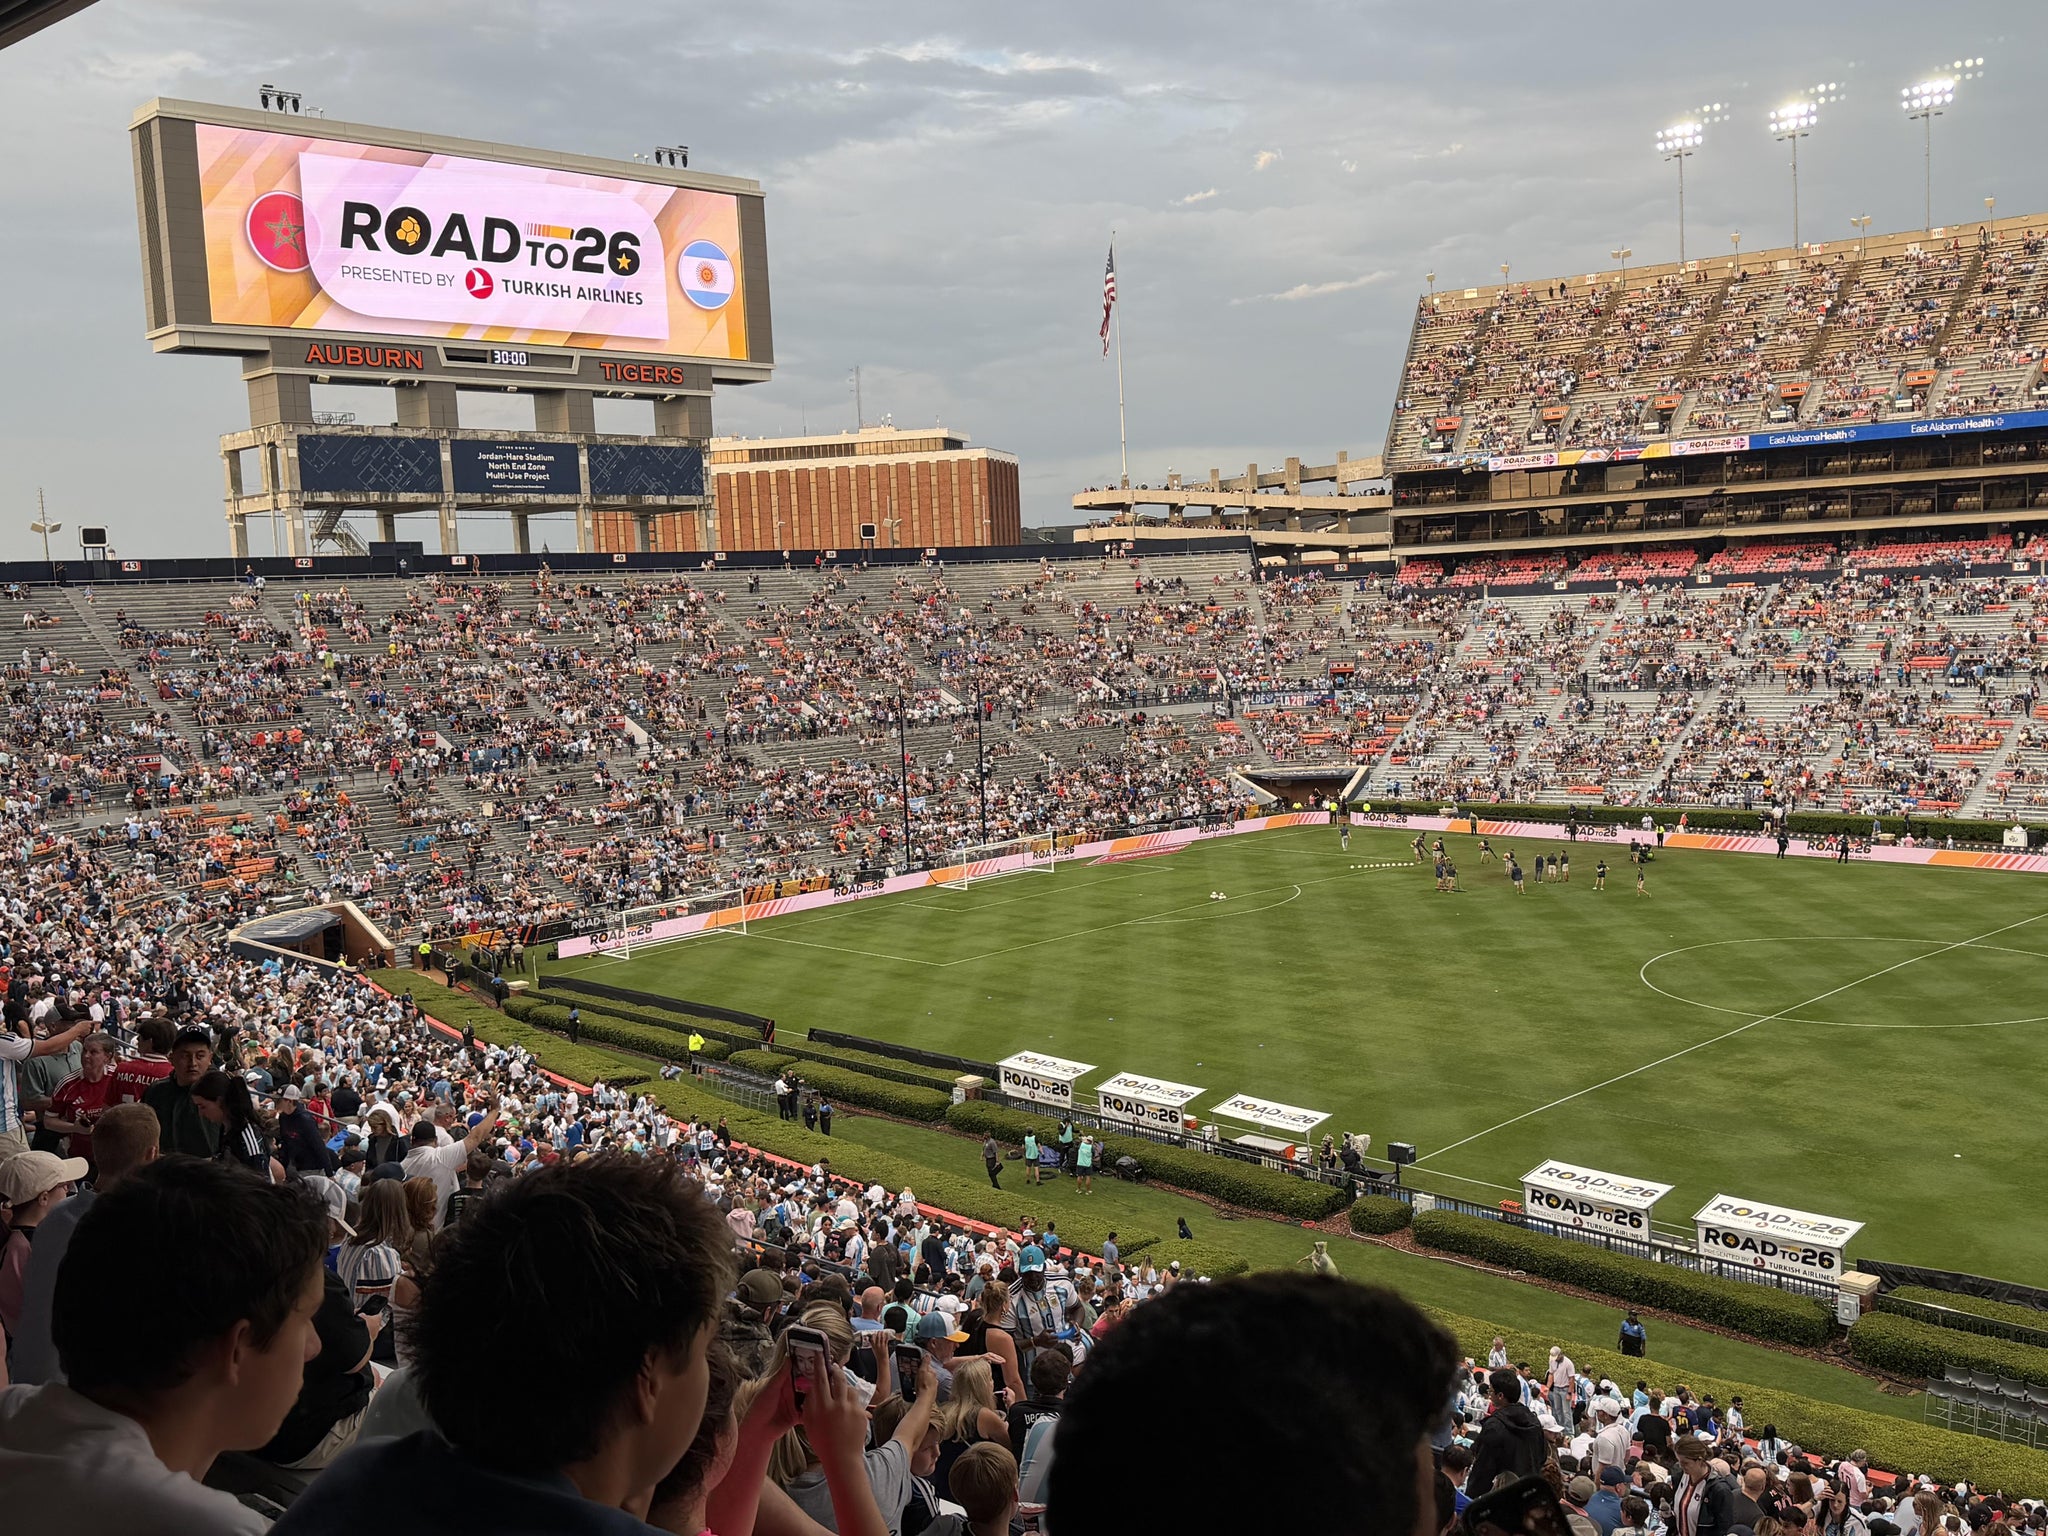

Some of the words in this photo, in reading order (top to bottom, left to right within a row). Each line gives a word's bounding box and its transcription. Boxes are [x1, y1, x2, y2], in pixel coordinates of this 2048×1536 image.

[340, 200, 521, 263] ROAD
[525, 241, 568, 269] TO
[572, 227, 641, 277] 26
[341, 265, 432, 286] PRESENTED
[436, 274, 455, 287] BY
[502, 279, 572, 299] TURKISH
[576, 286, 643, 305] AIRLINES
[305, 343, 423, 369] AUBURN
[494, 350, 527, 365] 30:00
[599, 361, 684, 384] TIGERS
[1911, 424, 1928, 433] East
[1769, 435, 1785, 445] East
[477, 452, 524, 460] Jordan-Hare
[525, 453, 555, 461] Stadium
[524, 472, 550, 481] Project
[1363, 813, 1388, 822] ROAD
[1396, 815, 1407, 823] 26
[1199, 824, 1220, 834] ROAD
[1564, 825, 1594, 836] RAD
[1604, 828, 1617, 837] 26
[1064, 845, 1074, 855] 26
[1855, 845, 1871, 853] 26
[834, 882, 863, 898] ROAD
[872, 880, 884, 890] 26
[571, 917, 600, 930] ROAD
[637, 923, 652, 935] 26
[117, 1072, 134, 1082] MAC
[1004, 1070, 1040, 1090] ROAD
[1041, 1084, 1051, 1093] TO
[1051, 1082, 1069, 1097] 26
[1112, 1078, 1160, 1091] ROAD
[1169, 1089, 1194, 1098] 26
[1103, 1096, 1145, 1116] ROAD
[1146, 1110, 1158, 1119] TO
[1159, 1108, 1179, 1124] 26
[1228, 1100, 1281, 1115] ROAD
[1290, 1114, 1319, 1124] 26
[1540, 1167, 1609, 1187] ROAD
[1606, 1183, 1624, 1191] TO
[1622, 1186, 1659, 1197] 26
[1530, 1188, 1594, 1216] ROAD
[1595, 1209, 1613, 1222] TO
[1613, 1209, 1643, 1229] 26
[1530, 1208, 1561, 1220] PRESENTED
[1586, 1221, 1614, 1234] TURKISH
[1615, 1228, 1643, 1240] AIRLINES
[1711, 1203, 1791, 1223] ROAD
[1787, 1220, 1808, 1229] TO
[1808, 1223, 1850, 1235] 26
[1771, 1225, 1804, 1236] TURKISH
[1805, 1231, 1839, 1241] AIRLINES
[1704, 1227, 1778, 1257] ROAD
[1779, 1249, 1800, 1262] TO
[1800, 1248, 1835, 1269] 26
[1703, 1248, 1740, 1261] PRESENTED
[1768, 1261, 1800, 1274] TURKISH
[1802, 1268, 1835, 1282] AIRLINES
